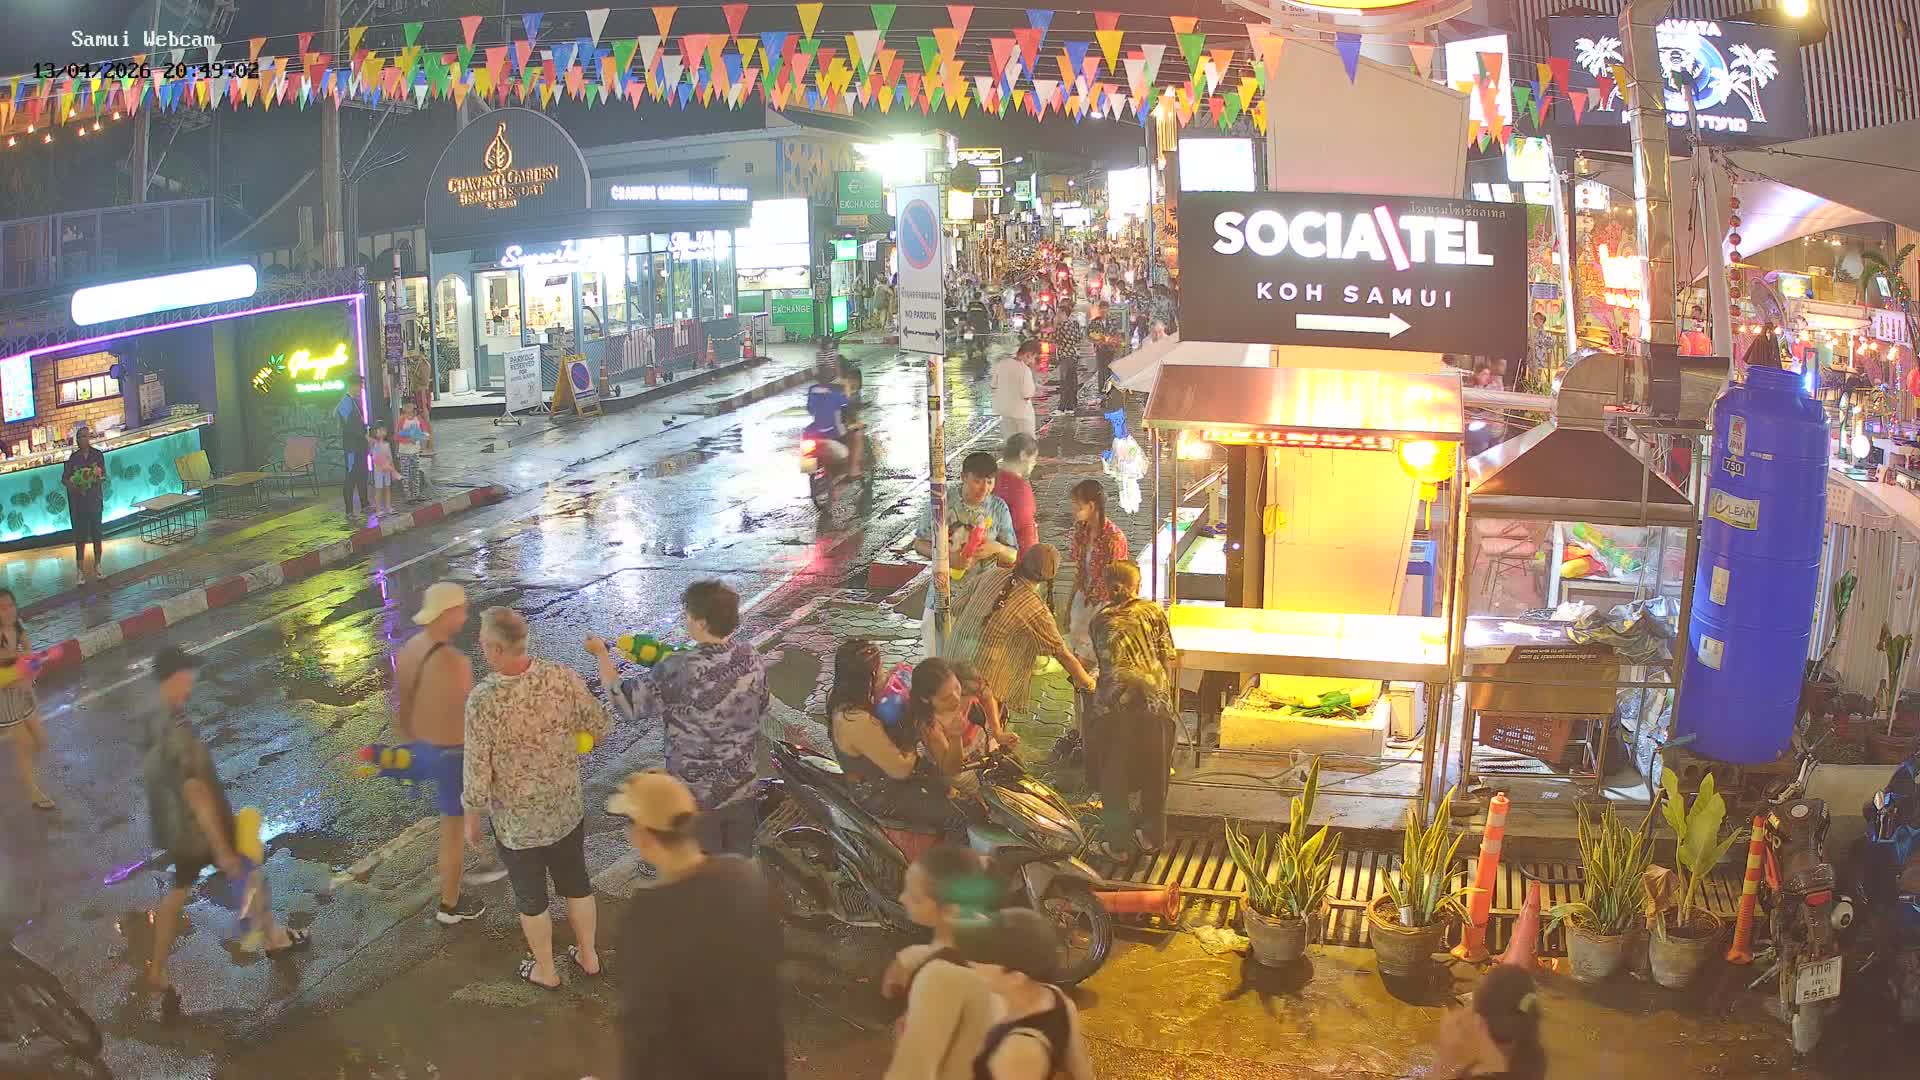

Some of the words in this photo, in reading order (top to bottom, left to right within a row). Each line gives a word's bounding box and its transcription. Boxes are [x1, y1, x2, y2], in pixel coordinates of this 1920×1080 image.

[507, 165, 560, 184] GARDEN
[839, 200, 881, 209] EXCHANGE
[1257, 282, 1323, 301] KOH
[1343, 285, 1452, 308] SAMUI
[773, 304, 811, 313] EXCHANGE
[904, 310, 912, 318] NO
[913, 311, 937, 320] PARKING
[1725, 461, 1741, 472] 750
